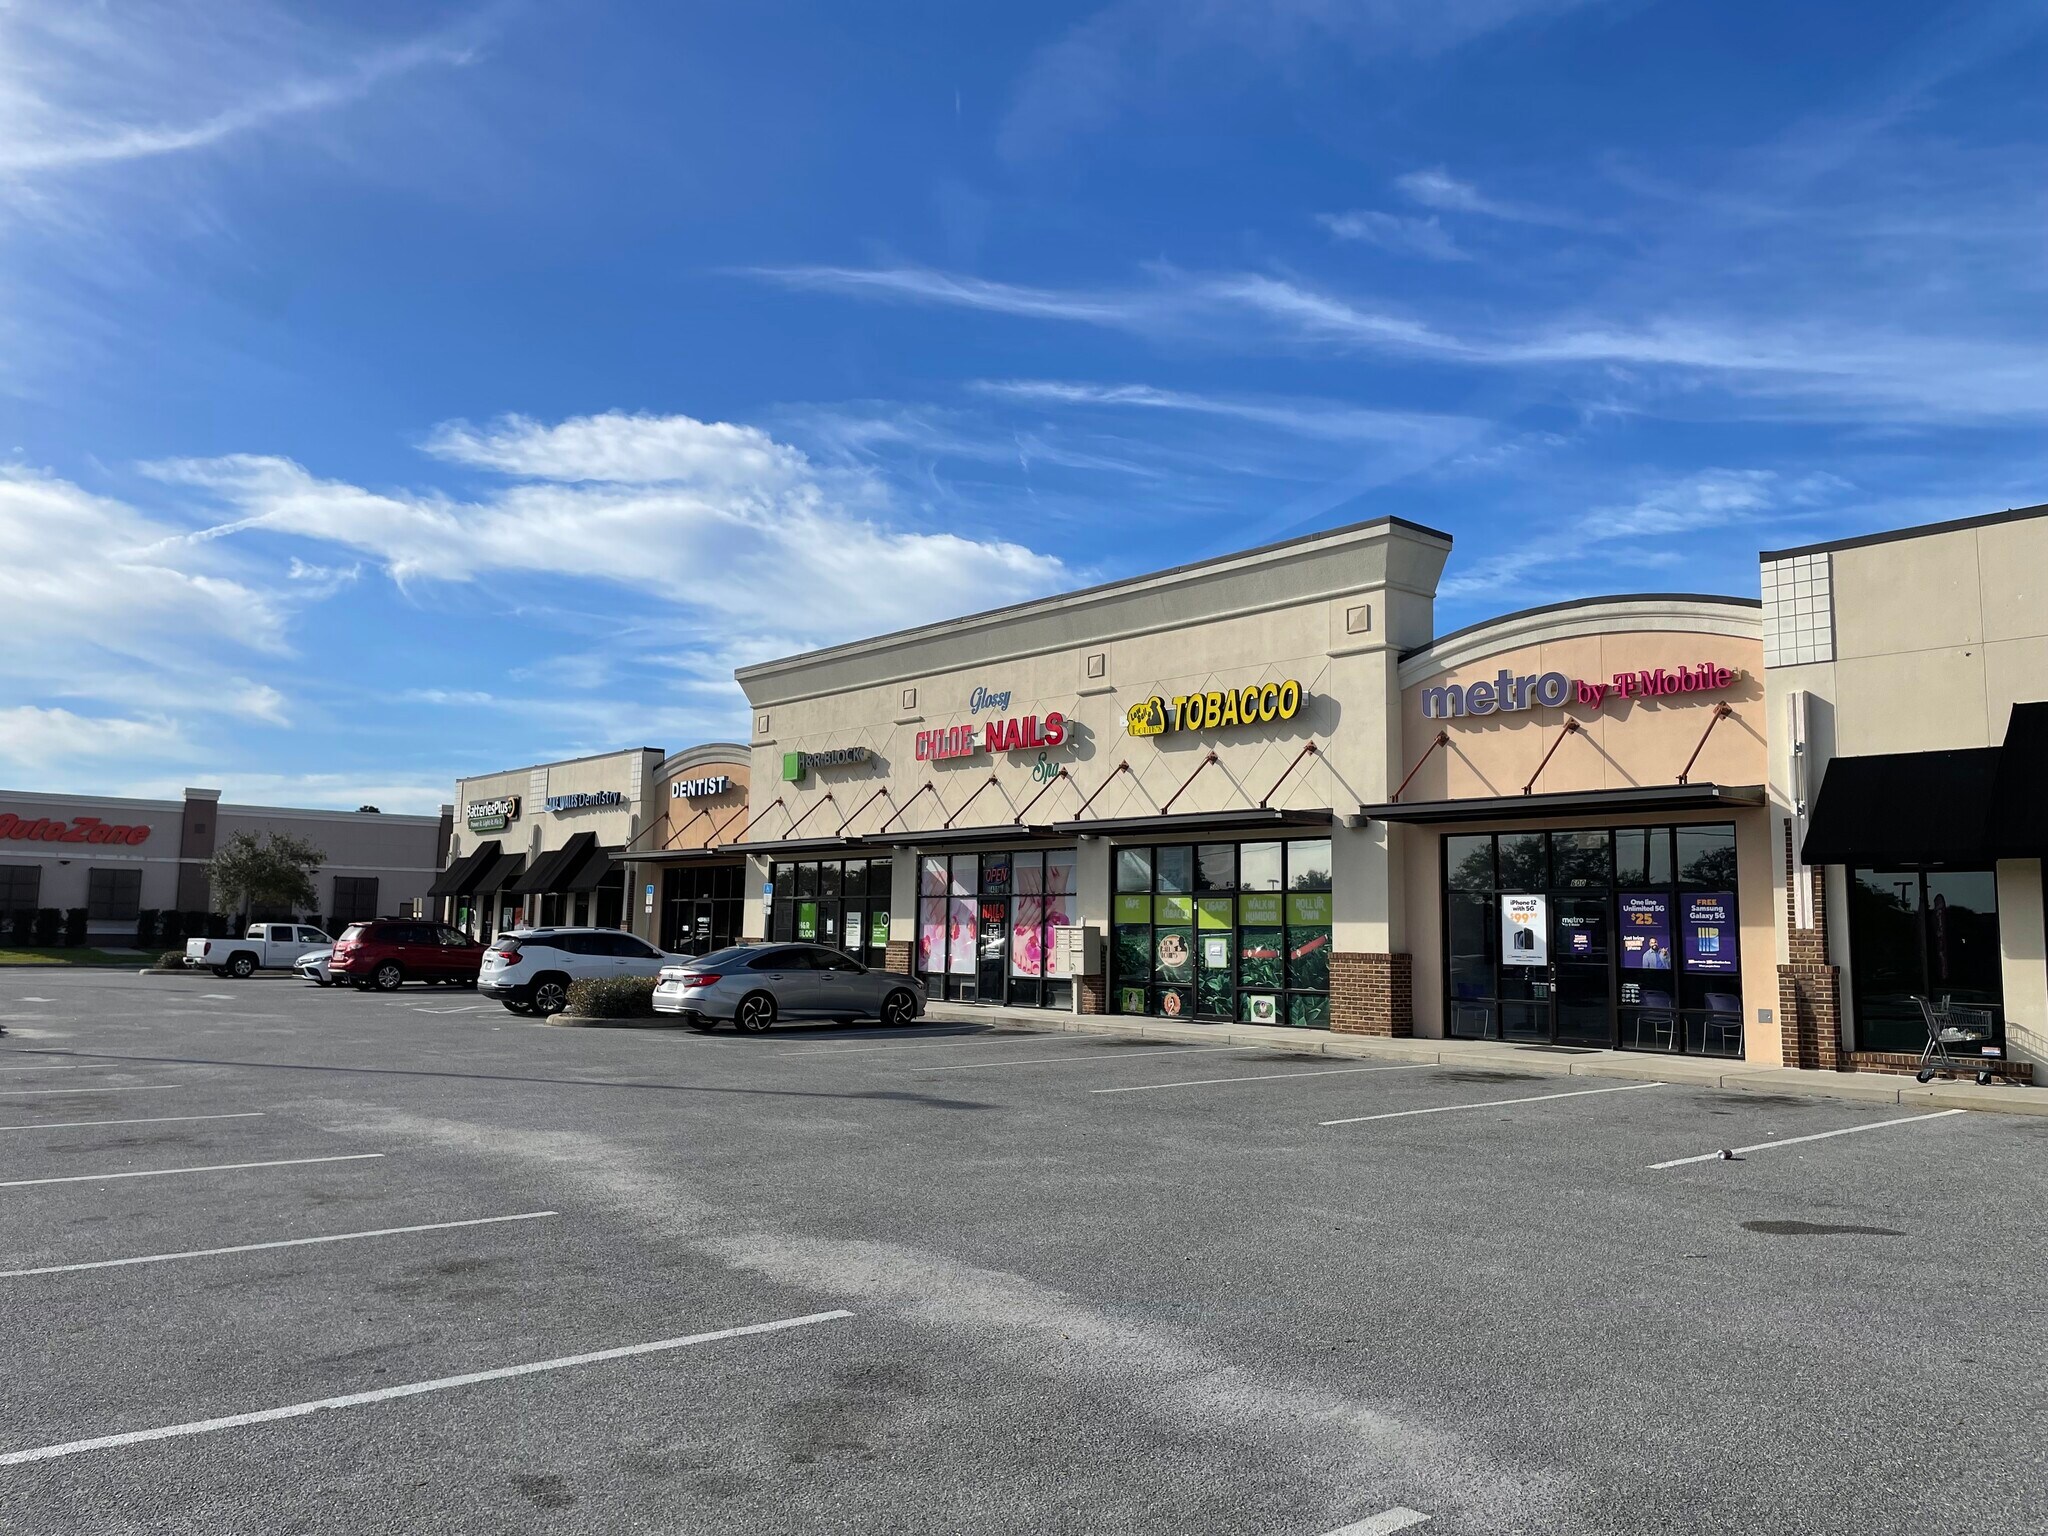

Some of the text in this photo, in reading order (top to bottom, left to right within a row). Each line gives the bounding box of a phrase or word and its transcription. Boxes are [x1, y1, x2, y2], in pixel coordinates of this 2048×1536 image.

[970, 687, 1011, 714] Glossy
[1421, 669, 1571, 718] metro
[1576, 679, 1608, 709] by
[1171, 679, 1301, 731] TOBACCO
[915, 711, 1072, 761] CHLOE NAILS
[799, 747, 865, 769] H&R BLOCK
[1032, 751, 1060, 784] Spa
[671, 775, 725, 798] DENTIST
[578, 791, 620, 806] Dentistry
[985, 868, 1007, 882] OPEN
[1571, 879, 1586, 887] 600
[982, 903, 1006, 919] NAILS
[1689, 912, 1714, 921] Galaxy
[1690, 905, 1724, 913] Samsung
[1561, 916, 1585, 924] metro
[1630, 912, 1653, 925] $25
